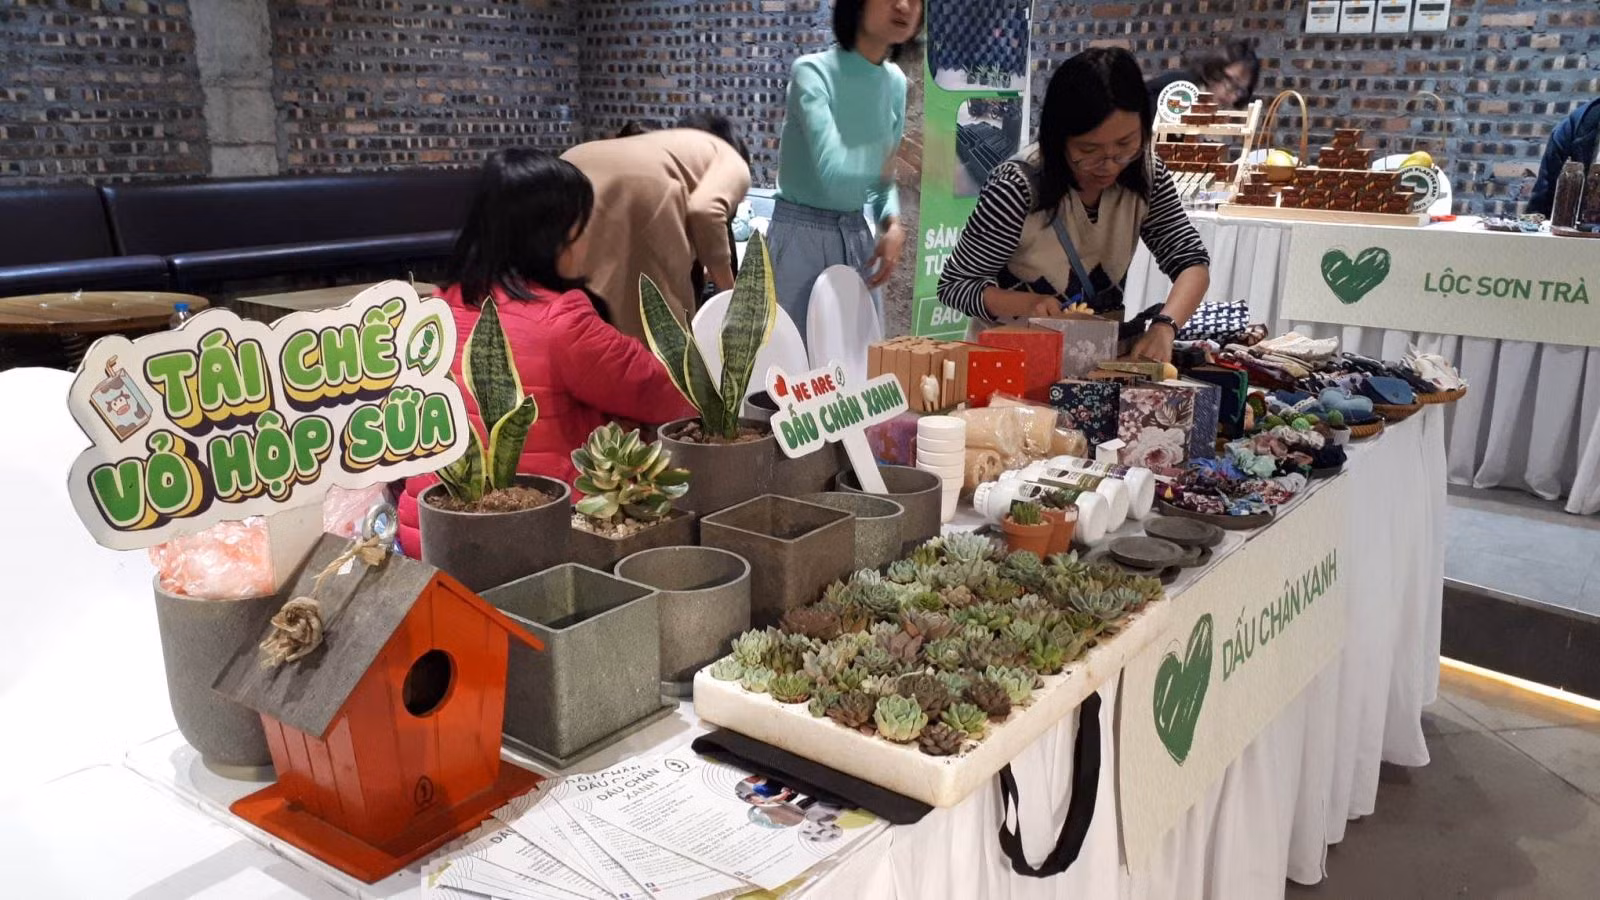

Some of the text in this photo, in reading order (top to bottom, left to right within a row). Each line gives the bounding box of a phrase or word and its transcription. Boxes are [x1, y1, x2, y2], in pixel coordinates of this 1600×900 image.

[1424, 267, 1590, 304] LỘC SƠN TRÀ
[144, 298, 405, 431] TÁI CHẾ
[791, 374, 836, 402] WE ARE
[780, 380, 904, 450] DẤU CHÂN XANH
[89, 386, 456, 530] VỎ HỘP SỮA
[1223, 548, 1337, 682] DẤU CHÂN XANH
[622, 780, 659, 800] XANH
